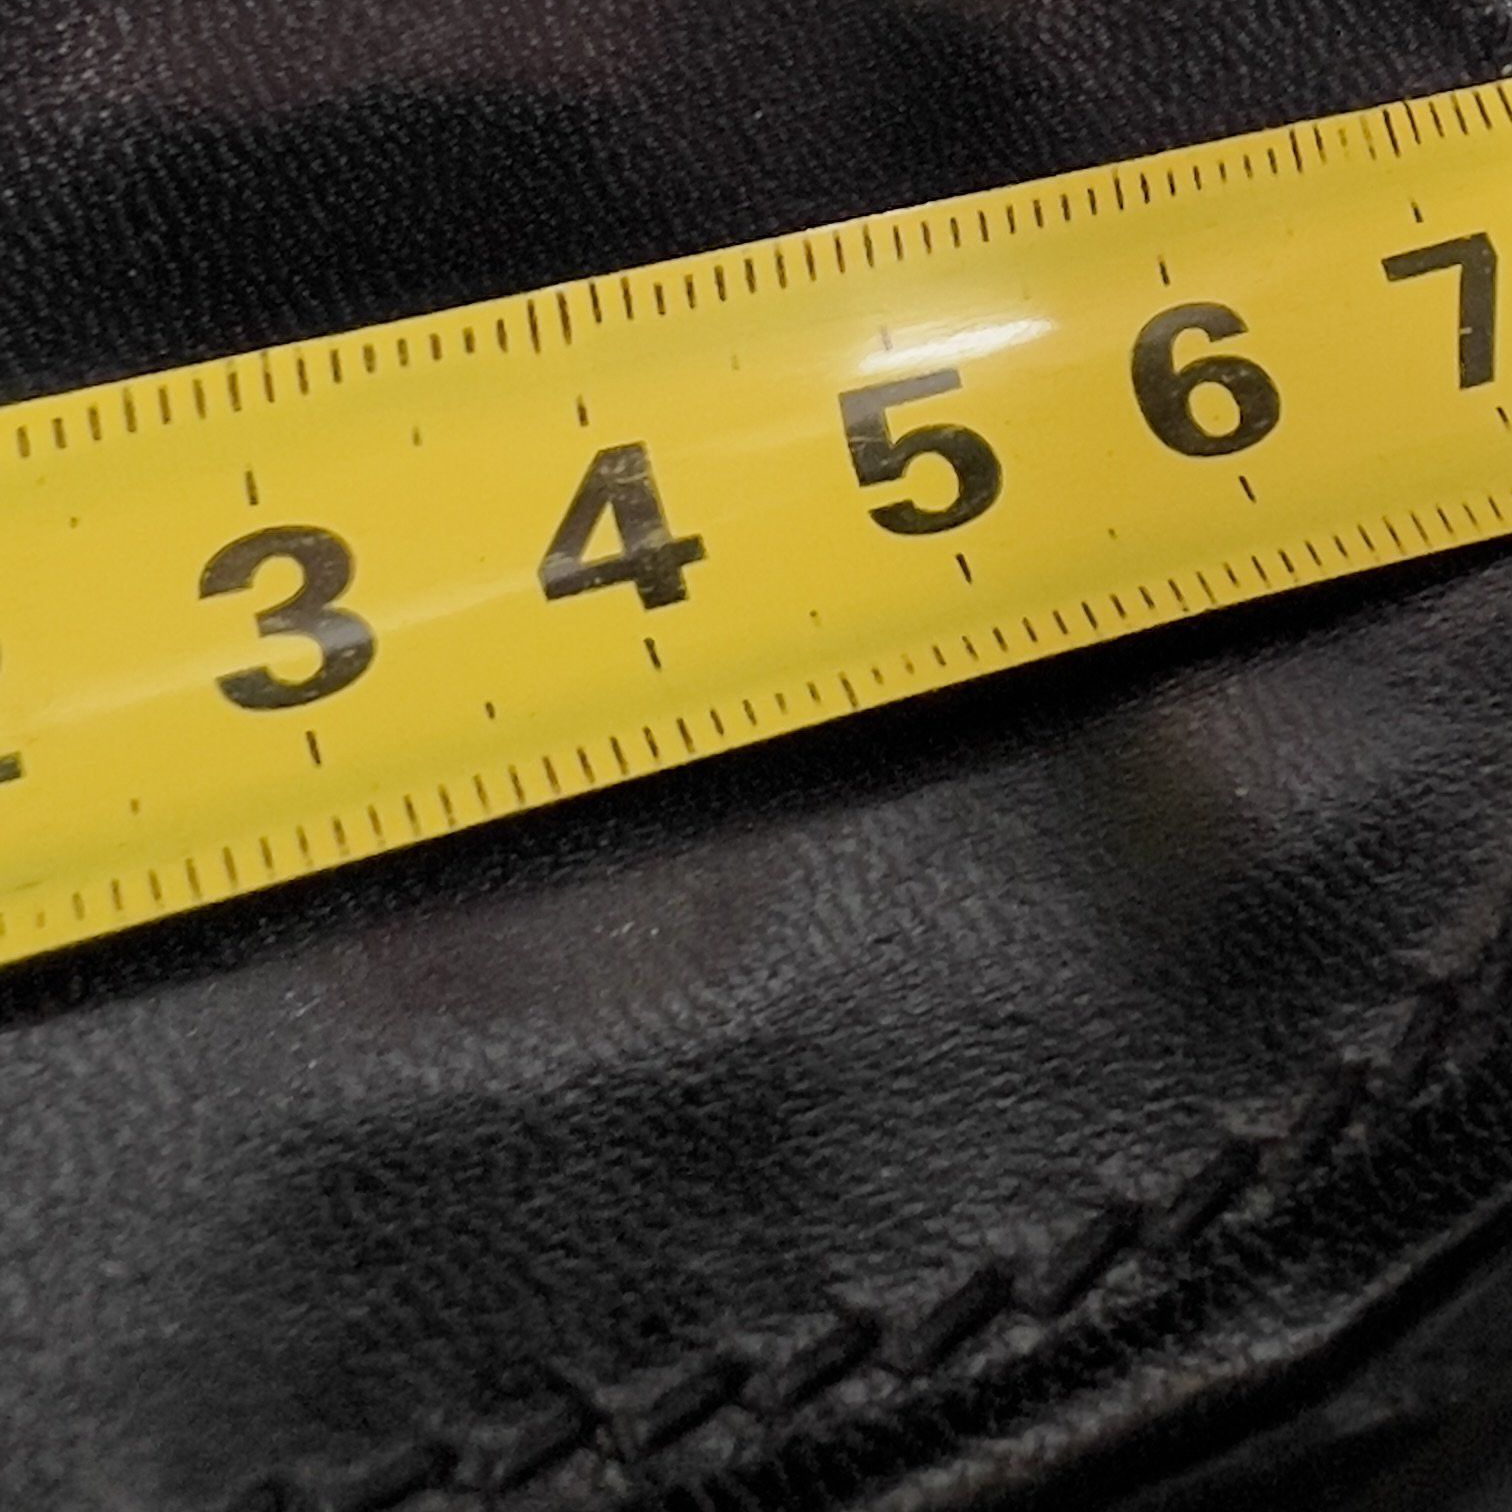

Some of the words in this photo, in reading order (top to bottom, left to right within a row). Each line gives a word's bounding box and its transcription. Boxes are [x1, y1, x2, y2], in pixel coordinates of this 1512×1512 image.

[198, 524, 375, 711] 3
[538, 441, 706, 612] 4
[839, 368, 1003, 536] 5
[1130, 301, 1282, 458] 6
[1381, 232, 1498, 391] 7
